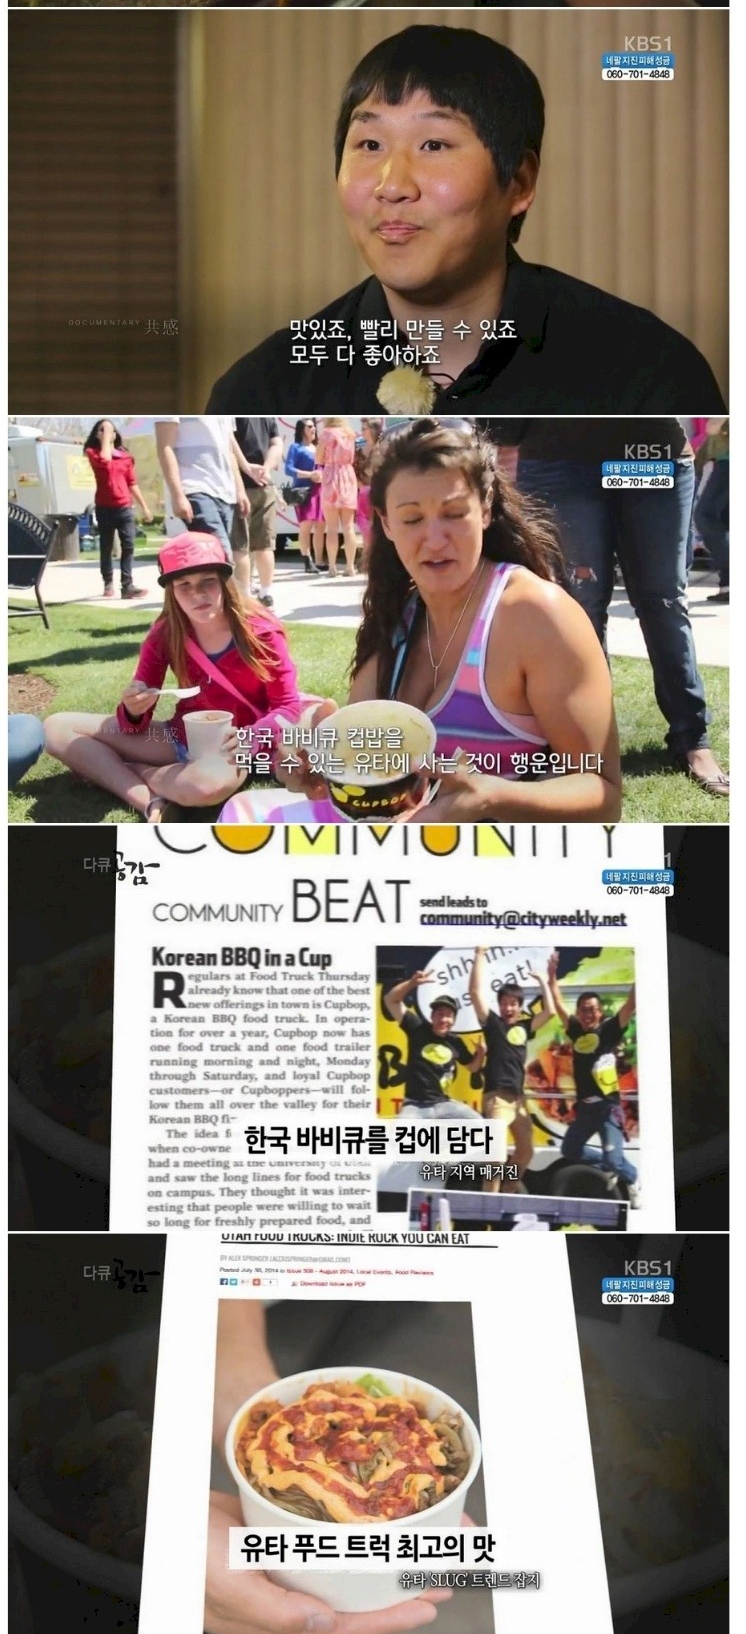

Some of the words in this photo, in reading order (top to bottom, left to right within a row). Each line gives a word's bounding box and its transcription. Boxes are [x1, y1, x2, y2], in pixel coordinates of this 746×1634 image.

[152, 902, 284, 923] COMMUNITY
[292, 878, 411, 924] BEAT
[419, 896, 446, 908] send
[446, 895, 475, 908] leads
[476, 896, 489, 908] to
[419, 909, 628, 930] community@cityweekly.net
[152, 946, 218, 967] Korean
[221, 946, 261, 970] BBQ
[264, 948, 282, 967] in
[284, 953, 296, 967] a
[298, 947, 332, 971] Cup
[177, 1042, 203, 1052] food
[210, 1042, 241, 1052] truck
[247, 1042, 269, 1052] and
[303, 1042, 328, 1052] food
[334, 1042, 371, 1051] trailer
